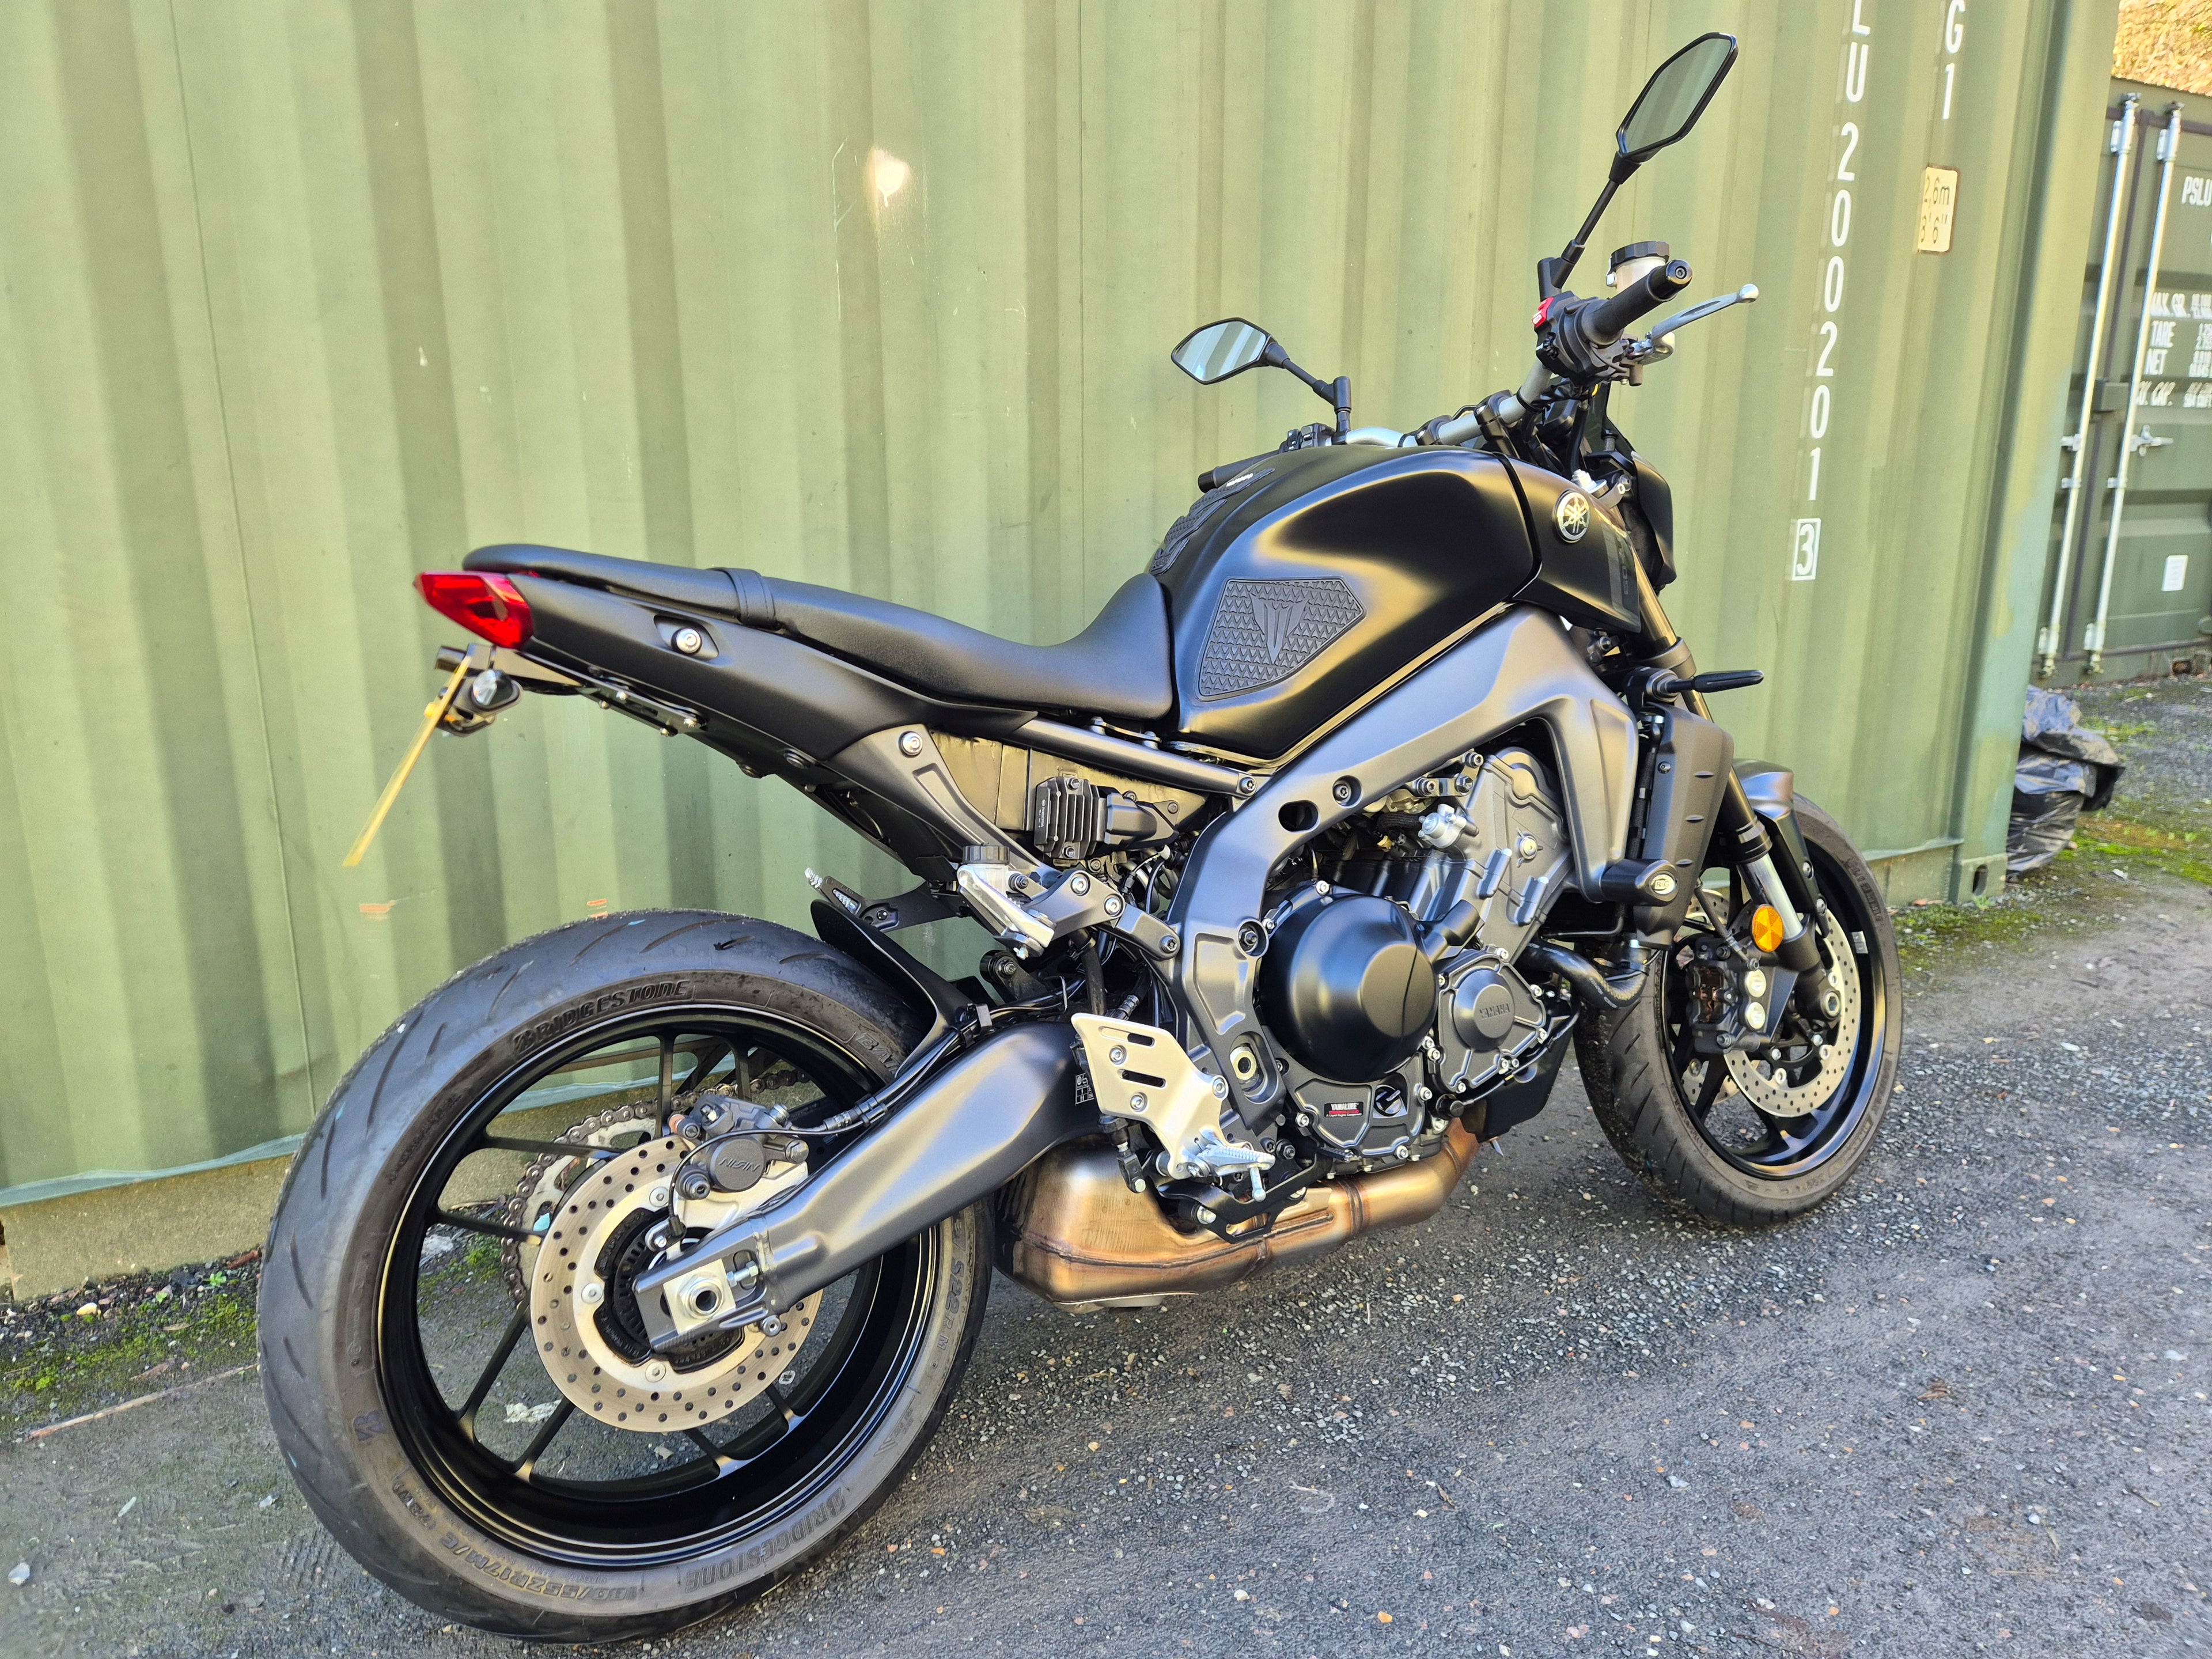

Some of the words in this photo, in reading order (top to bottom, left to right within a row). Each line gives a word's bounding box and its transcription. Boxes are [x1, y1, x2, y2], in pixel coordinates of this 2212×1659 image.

[2150, 320, 2176, 349] TARE
[2145, 348, 2168, 375] NET
[513, 979, 691, 1052] BRIDGESTONE
[684, 1487, 847, 1594] BRIDGESTONE
